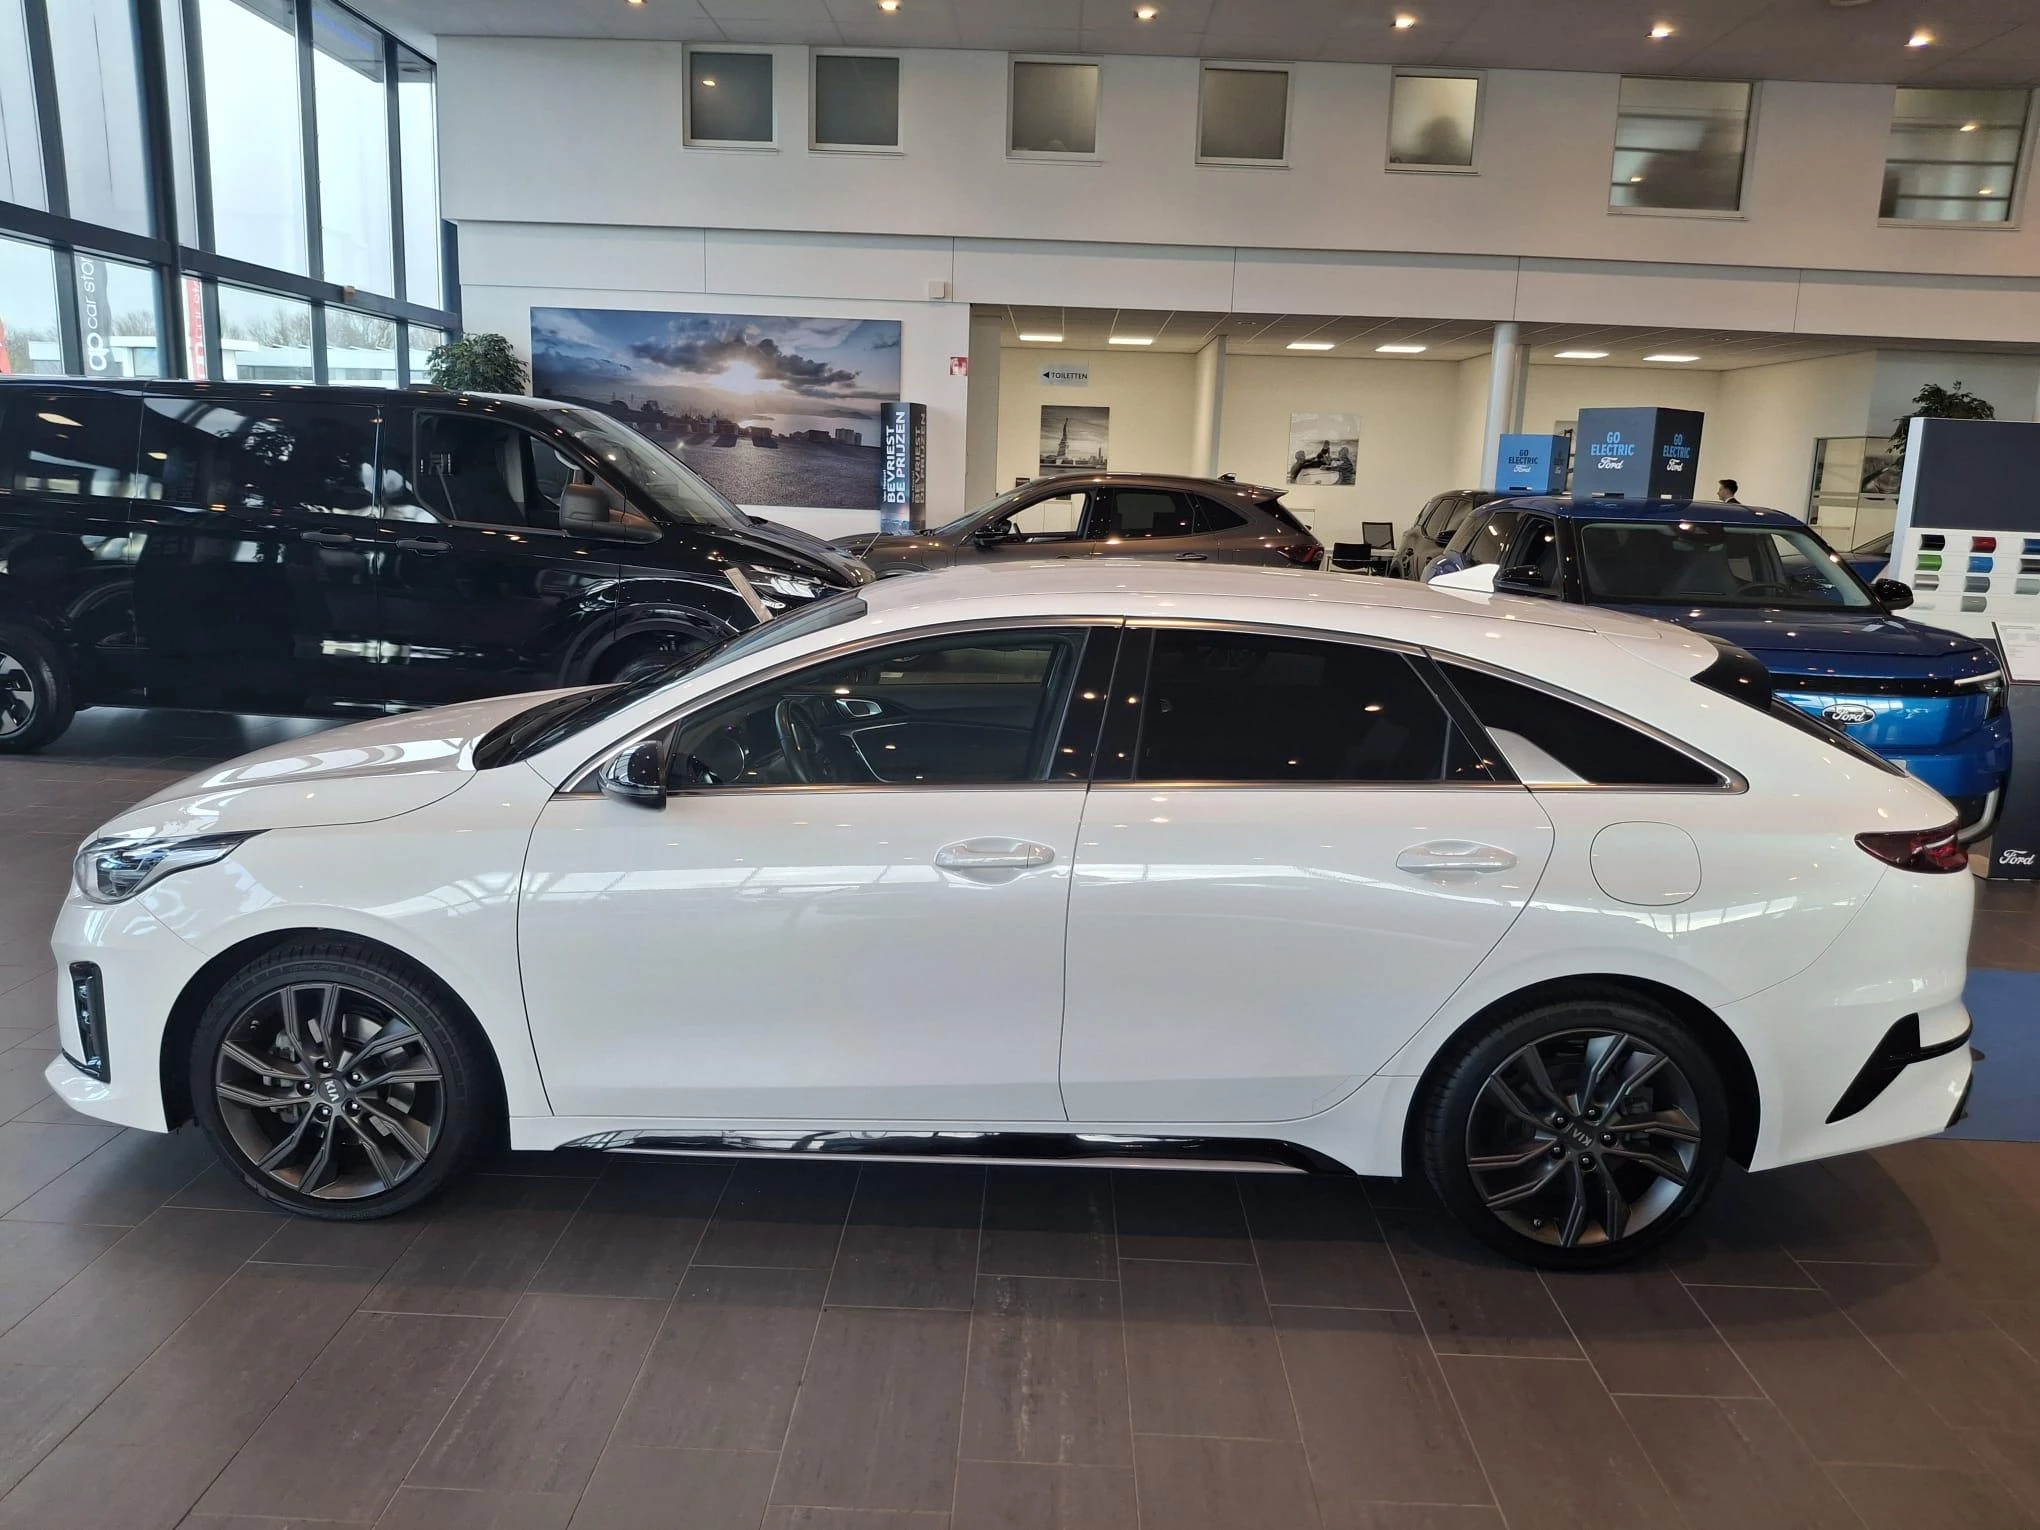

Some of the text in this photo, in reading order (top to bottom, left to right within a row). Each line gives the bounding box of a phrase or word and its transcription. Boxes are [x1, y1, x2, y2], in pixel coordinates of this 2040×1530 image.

[86, 296, 98, 330] car
[1052, 371, 1088, 380] TOILETTEN
[1607, 431, 1620, 443] GO
[1673, 433, 1683, 445] GO
[1591, 444, 1635, 456] ELECTRIC
[1662, 445, 1691, 458] ELECTRIC
[896, 411, 905, 503] DE PRIJZEN
[1508, 456, 1539, 464] ELECTRIC
[1598, 456, 1624, 470] Ford
[886, 425, 896, 503] BEVRIEST
[1513, 465, 1532, 473] Ford
[1666, 458, 1684, 471] Ford
[1831, 707, 1867, 722] Ford
[1999, 849, 2036, 865] Ford
[324, 1080, 340, 1102] KIA
[1572, 1128, 1592, 1146] KIA
